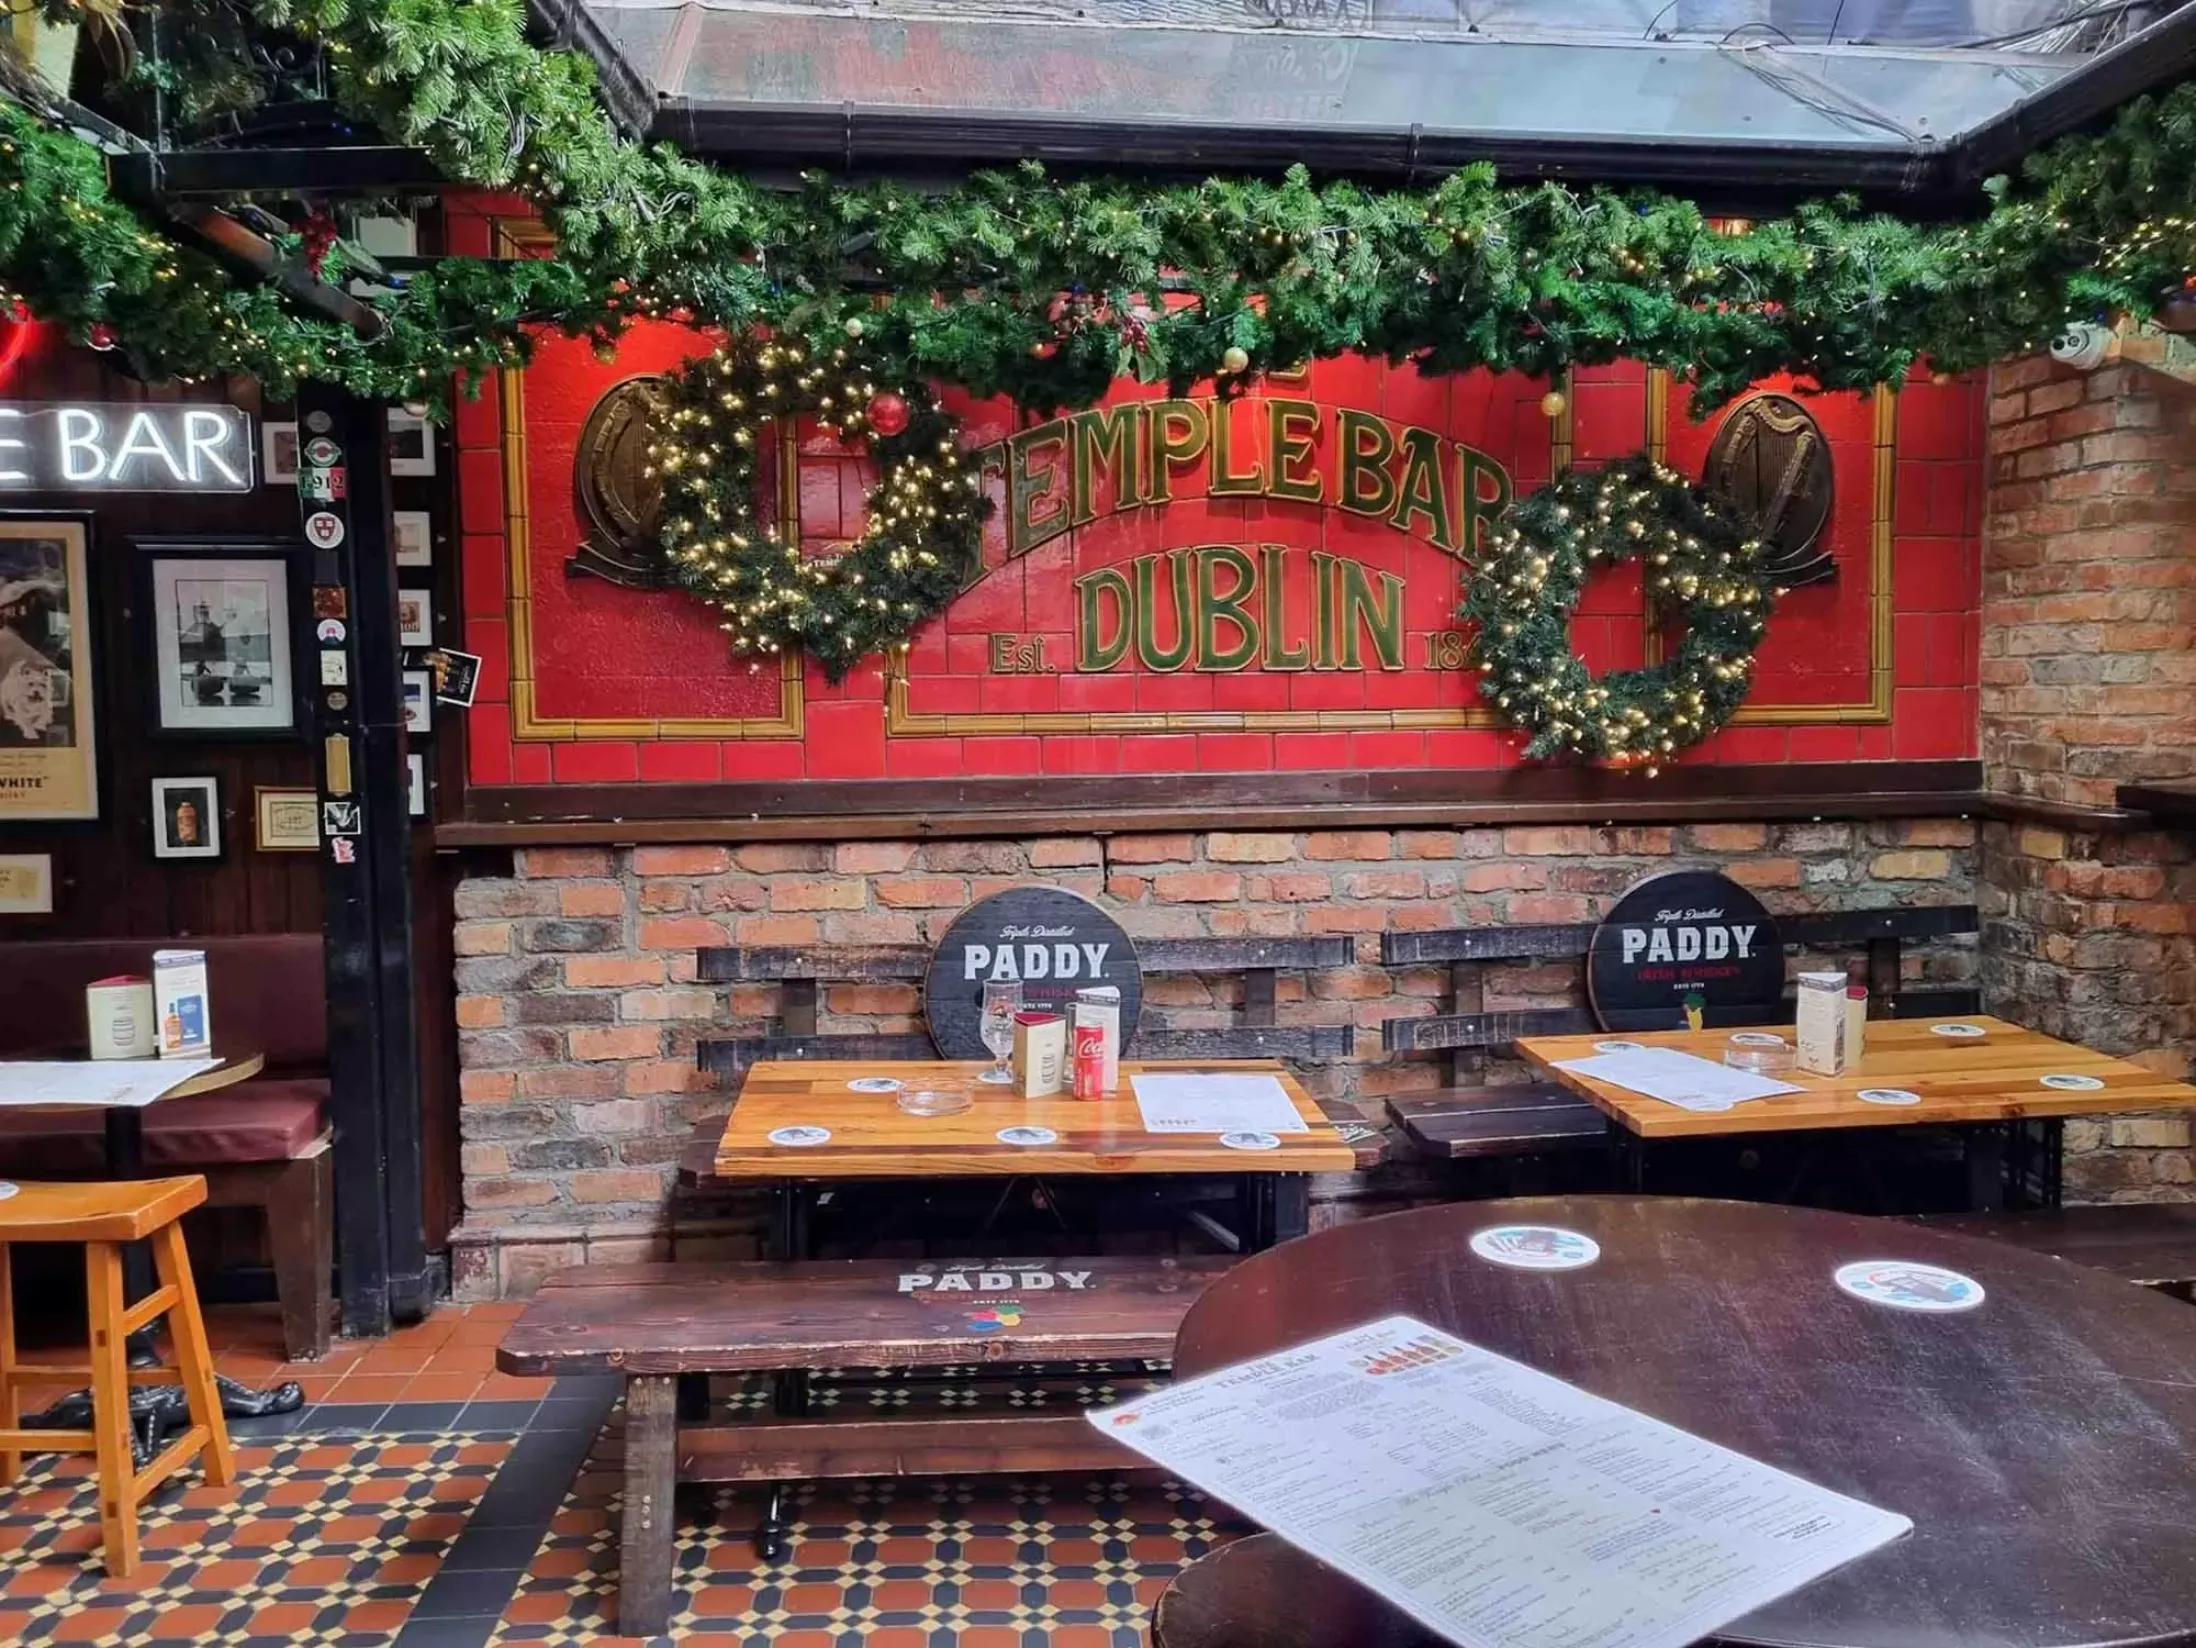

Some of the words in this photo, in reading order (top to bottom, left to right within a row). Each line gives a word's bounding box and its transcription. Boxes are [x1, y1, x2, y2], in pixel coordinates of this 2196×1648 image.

[57, 407, 246, 487] BAR
[1337, 407, 1513, 566] BAR
[990, 631, 1056, 673] Est.
[1074, 543, 1405, 673] DUBLIN
